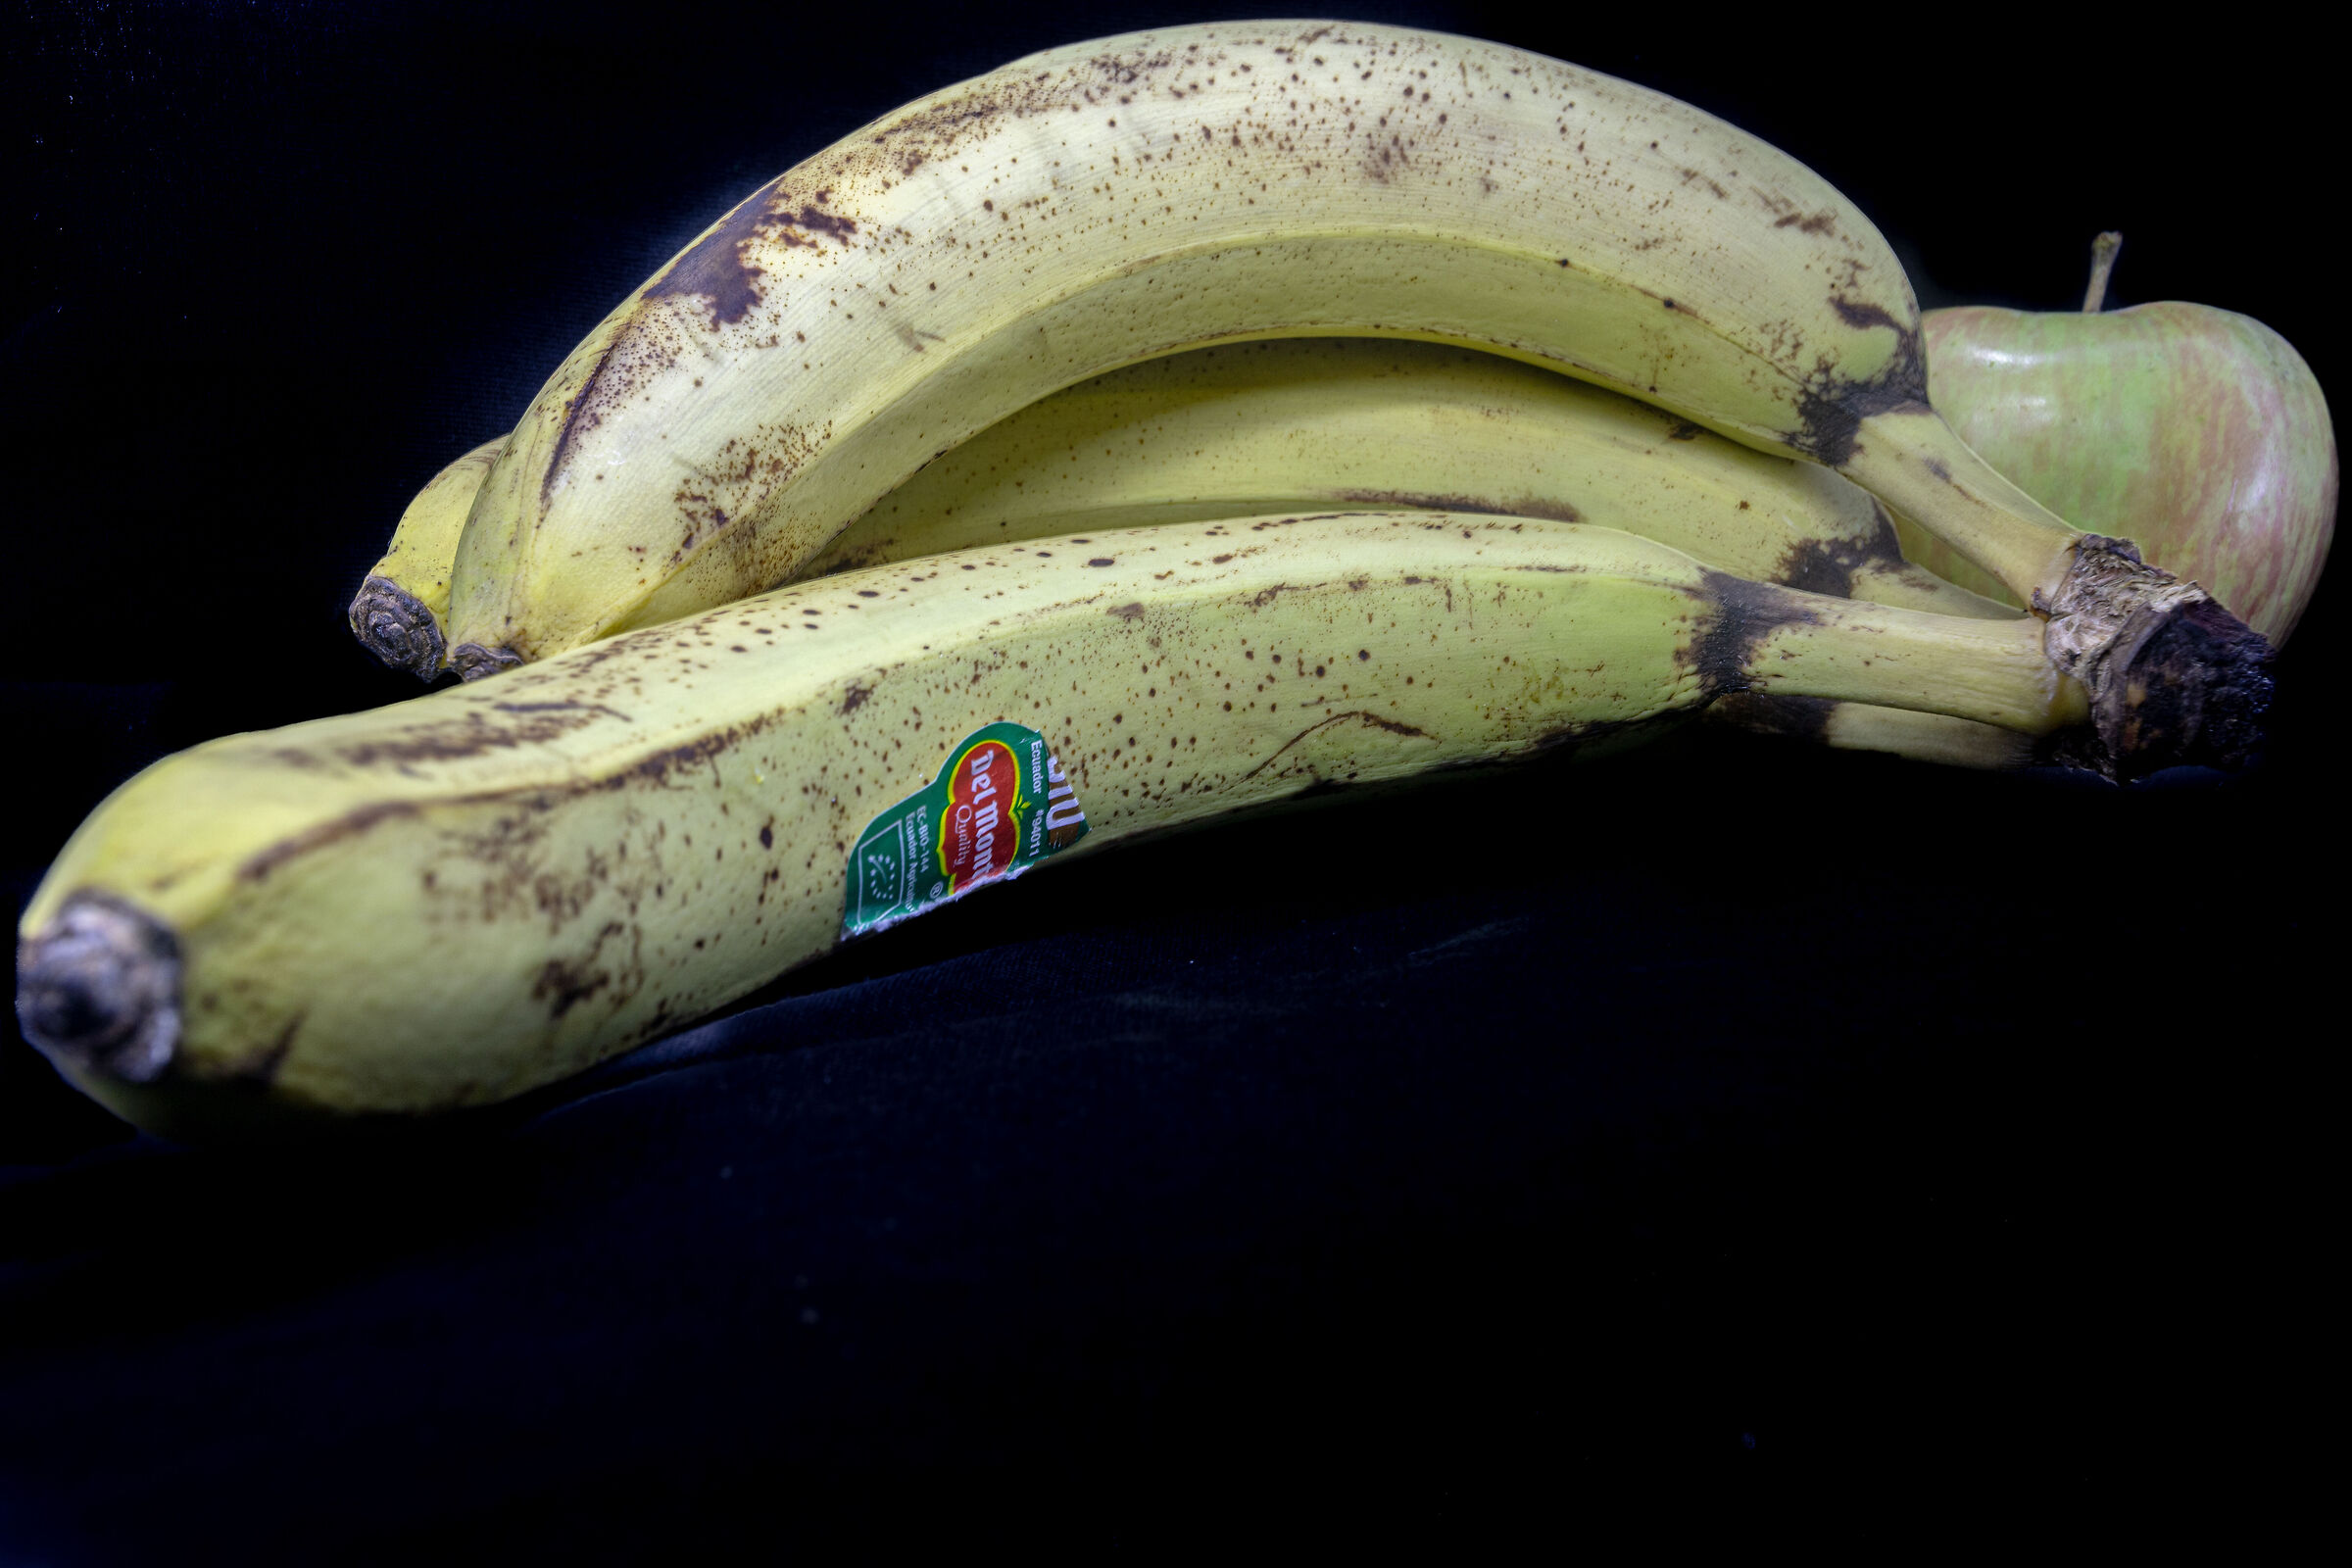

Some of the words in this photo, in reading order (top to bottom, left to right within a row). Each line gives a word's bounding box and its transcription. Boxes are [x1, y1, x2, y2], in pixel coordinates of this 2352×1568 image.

[970, 749, 997, 805] Del
[1030, 739, 1044, 795] Ecuador
[905, 810, 918, 861] Ecuador
[916, 804, 931, 873] EC-BIO-144
[954, 805, 972, 865] Quality
[1029, 808, 1044, 858] #94011
